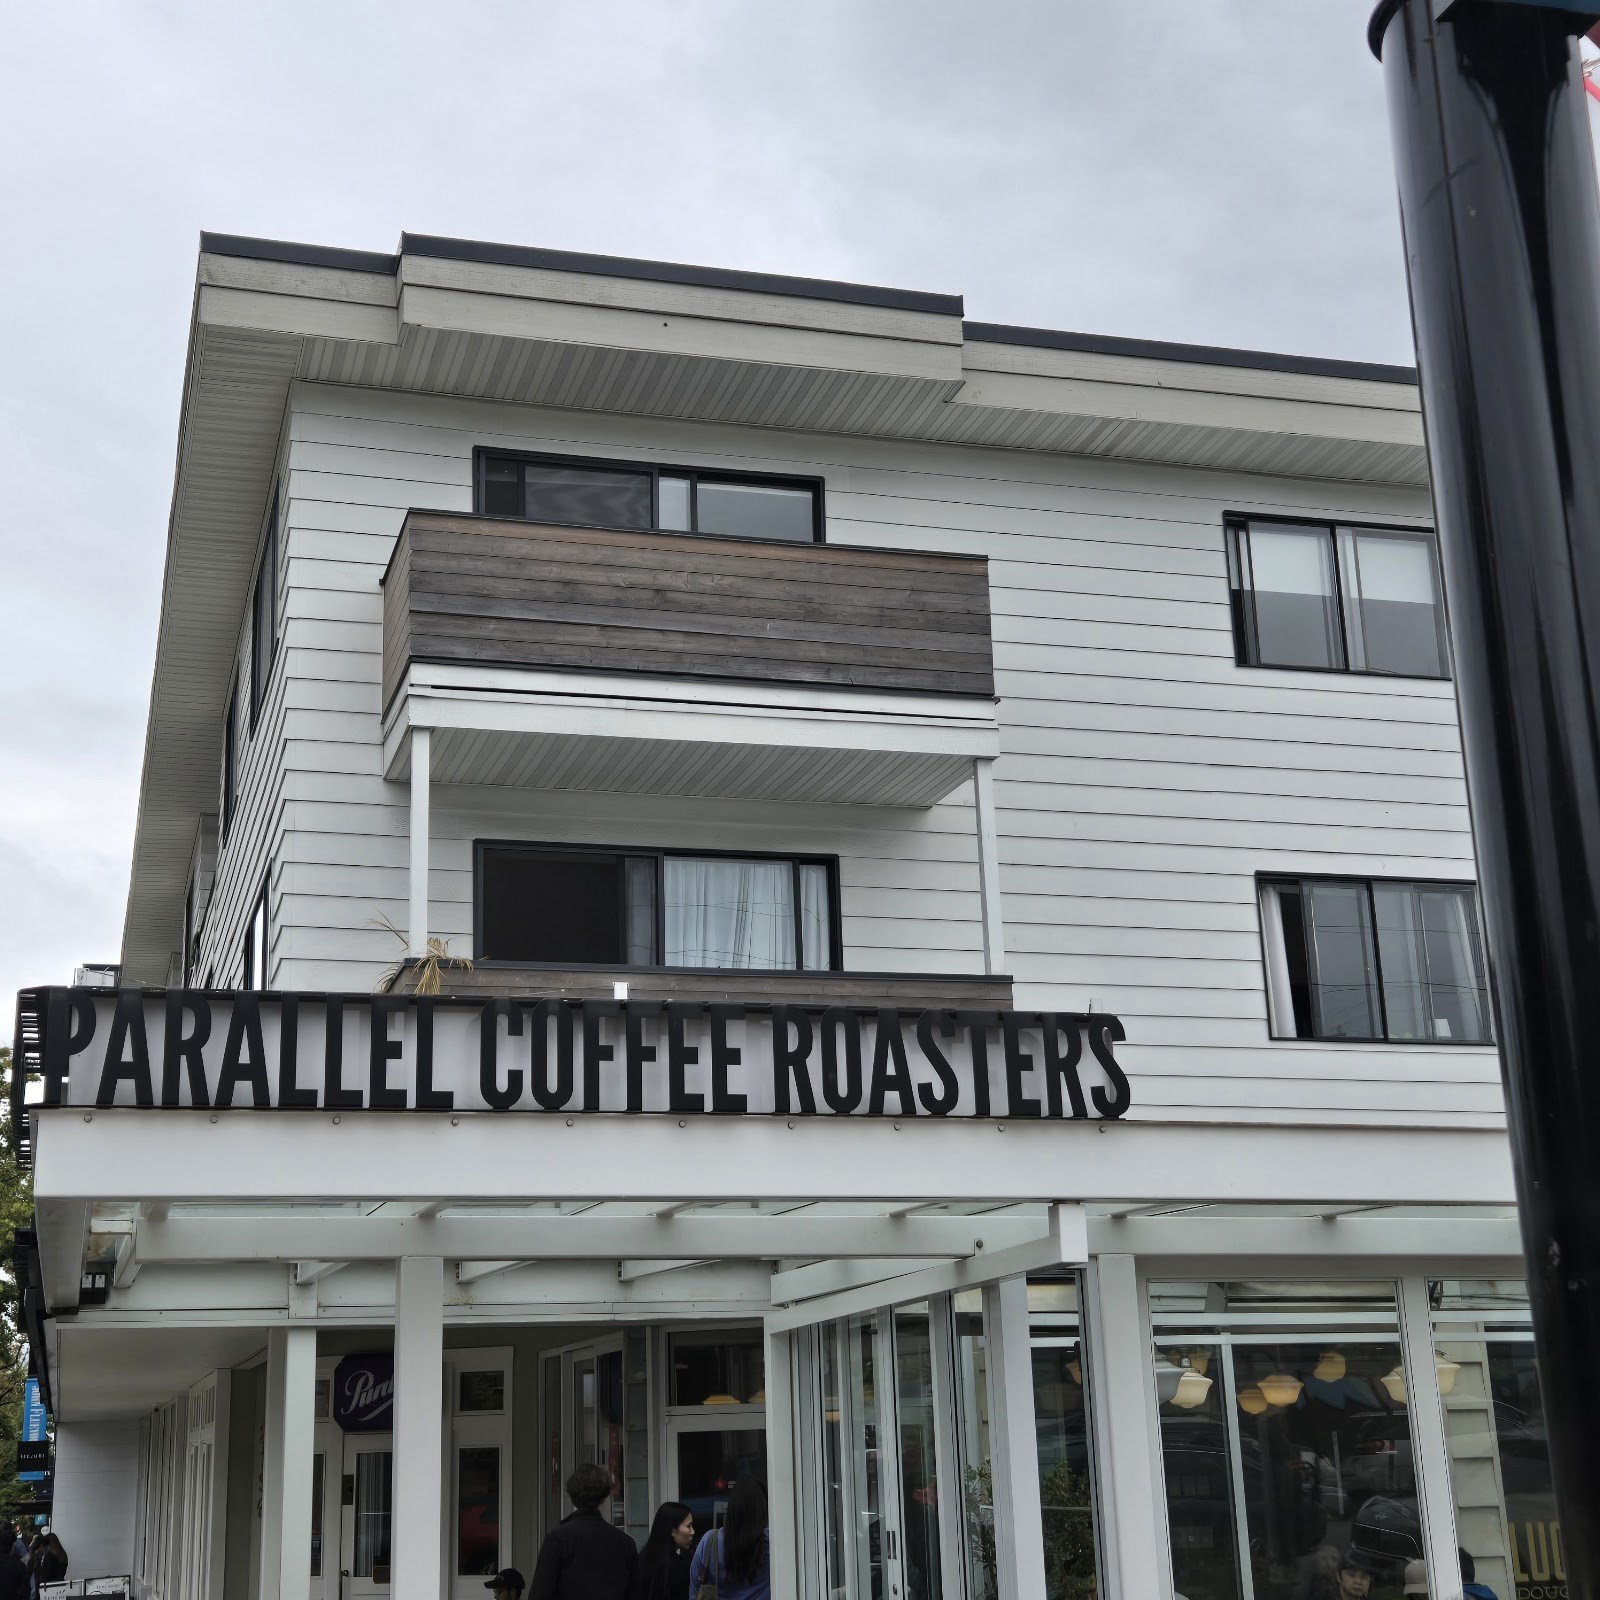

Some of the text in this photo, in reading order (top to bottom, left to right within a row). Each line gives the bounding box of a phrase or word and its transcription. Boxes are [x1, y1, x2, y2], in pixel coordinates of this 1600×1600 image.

[44, 987, 455, 1109] PARALLEL
[480, 996, 748, 1112] COFFEE
[772, 1002, 1132, 1118] ROASTERS
